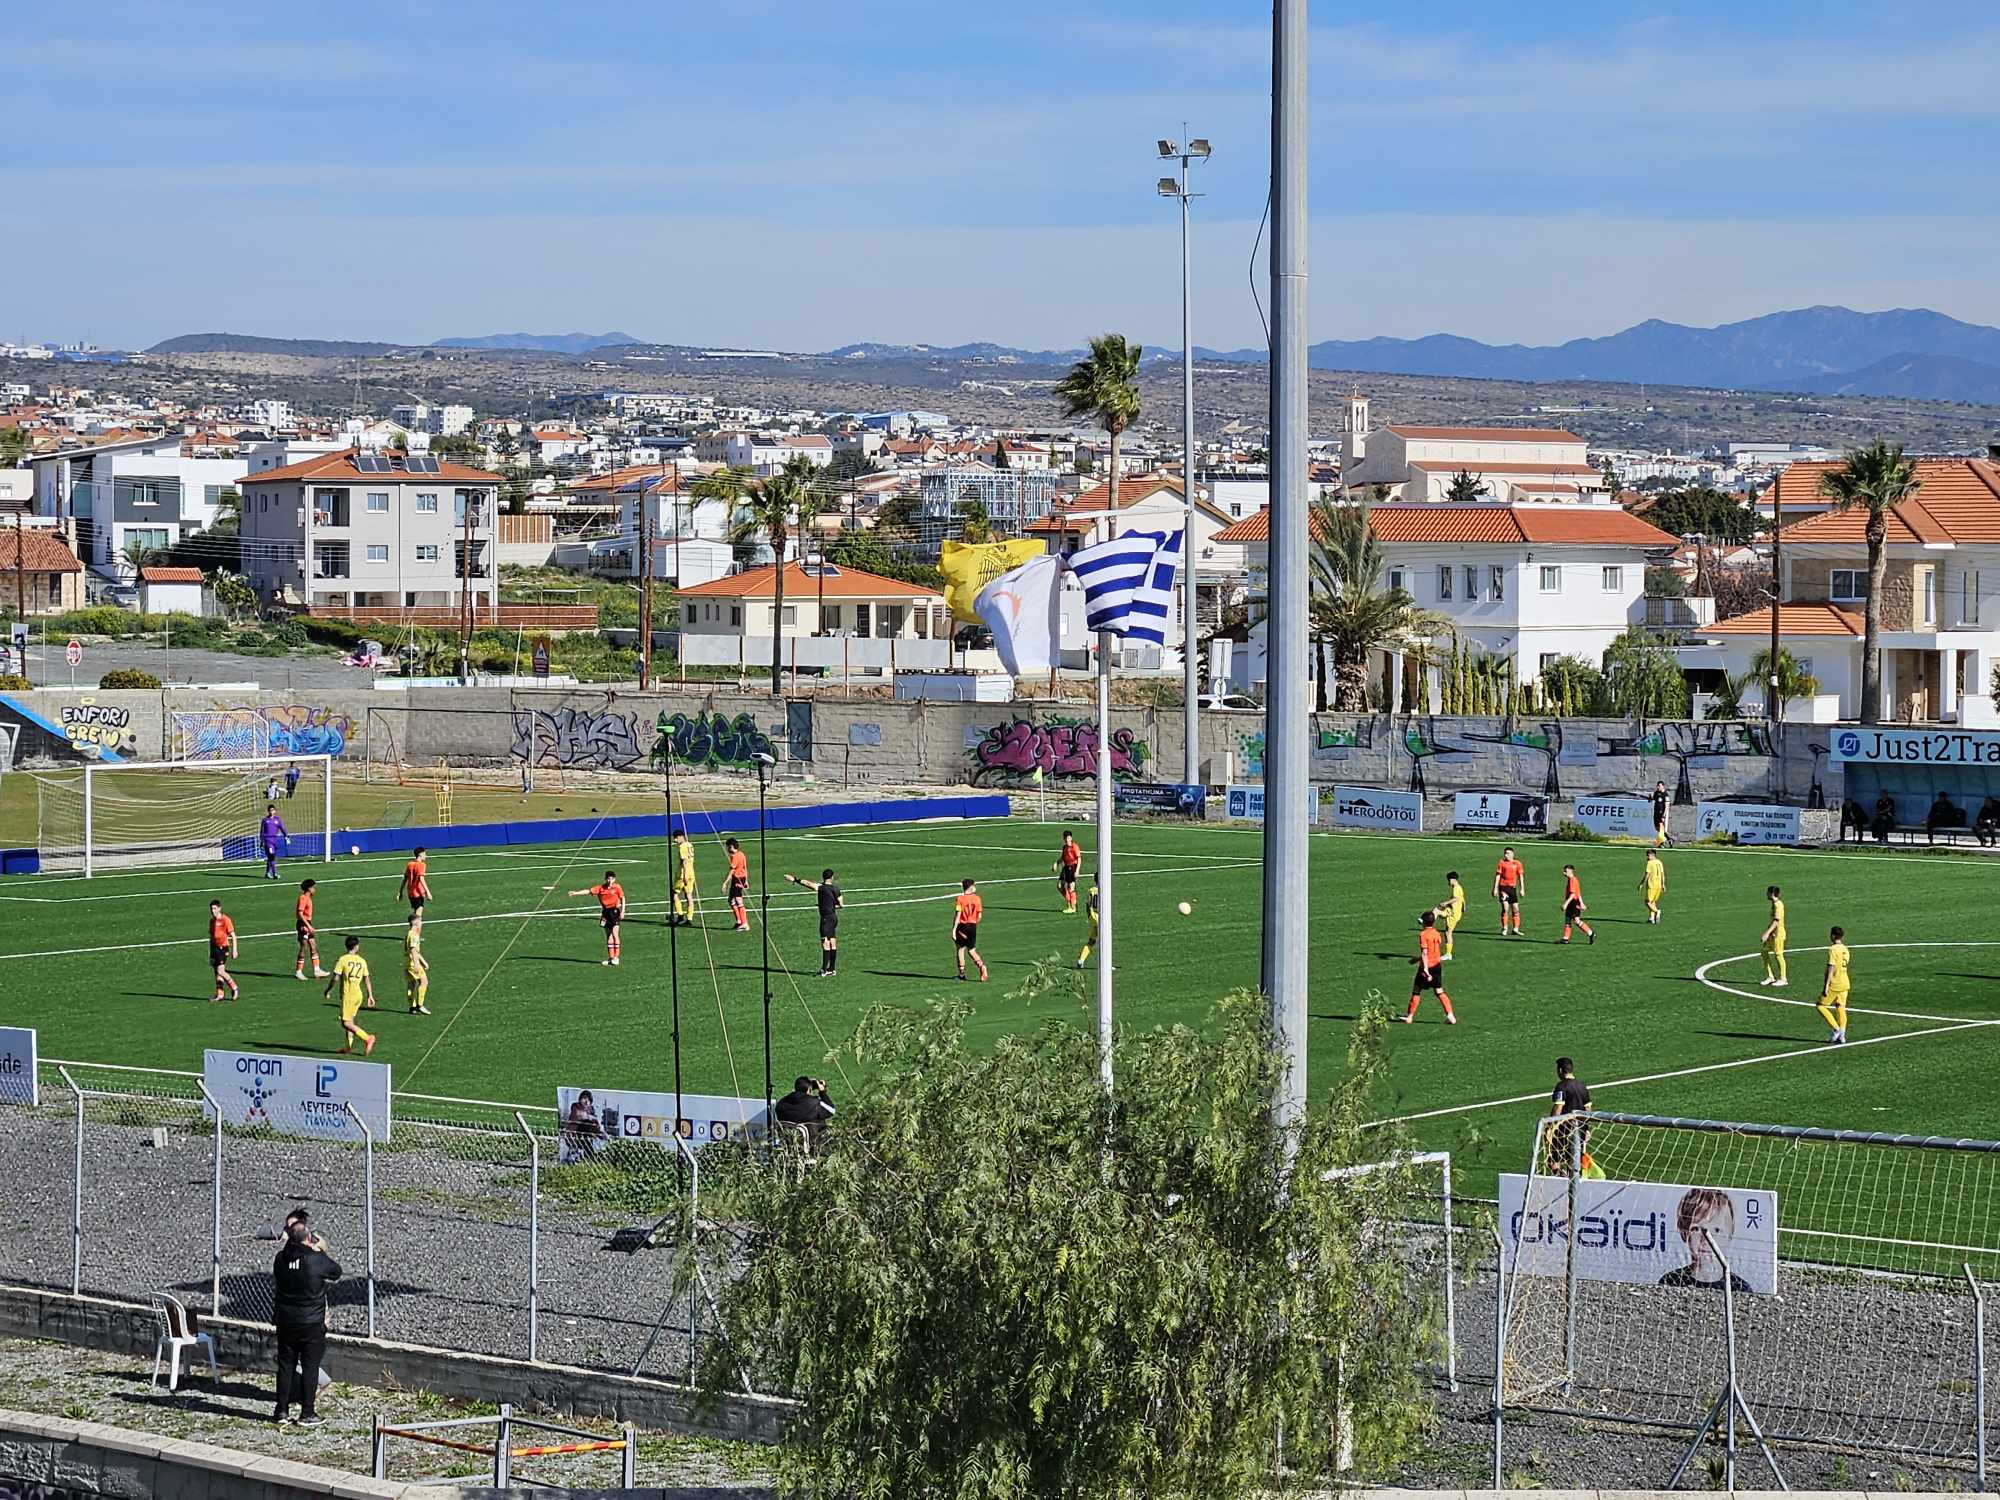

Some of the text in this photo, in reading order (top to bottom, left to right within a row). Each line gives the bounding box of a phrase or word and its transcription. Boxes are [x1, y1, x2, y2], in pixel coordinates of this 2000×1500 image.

[61, 706, 129, 728] ENFORI
[65, 724, 120, 748] CREW
[1866, 733, 2000, 762] Just2Tra
[1467, 809, 1500, 819] CASTLE
[1577, 804, 1625, 818] COFFEE
[348, 961, 362, 979] 22
[628, 1120, 723, 1137] PABLOS
